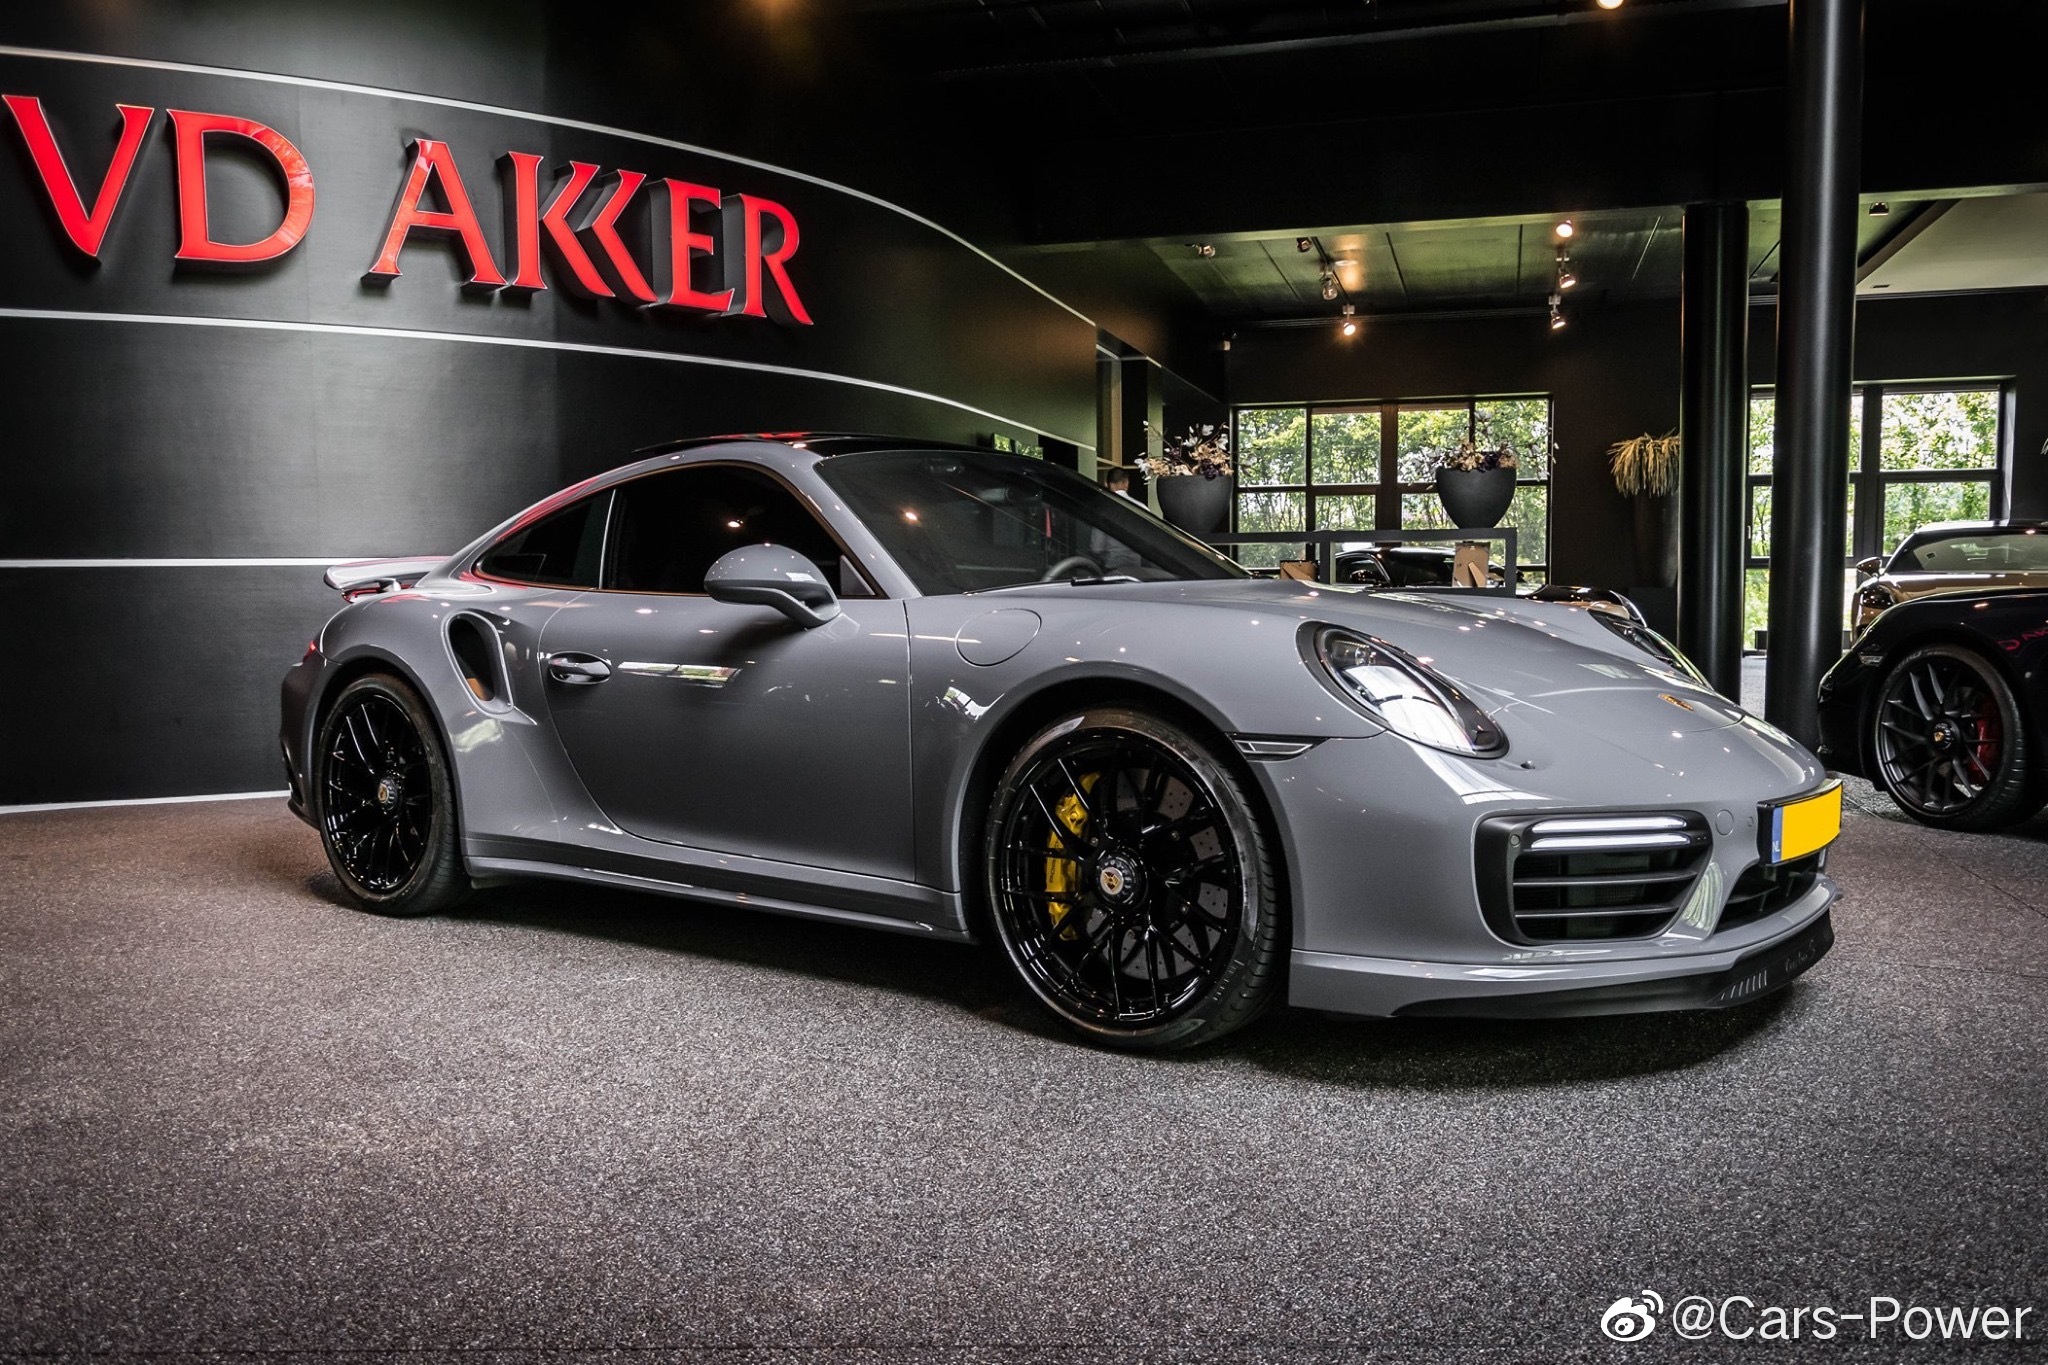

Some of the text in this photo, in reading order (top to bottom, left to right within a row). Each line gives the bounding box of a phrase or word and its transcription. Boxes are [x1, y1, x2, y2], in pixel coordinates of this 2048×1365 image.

[2, 94, 814, 326] VD AKKER
[1772, 840, 1781, 854] NL
